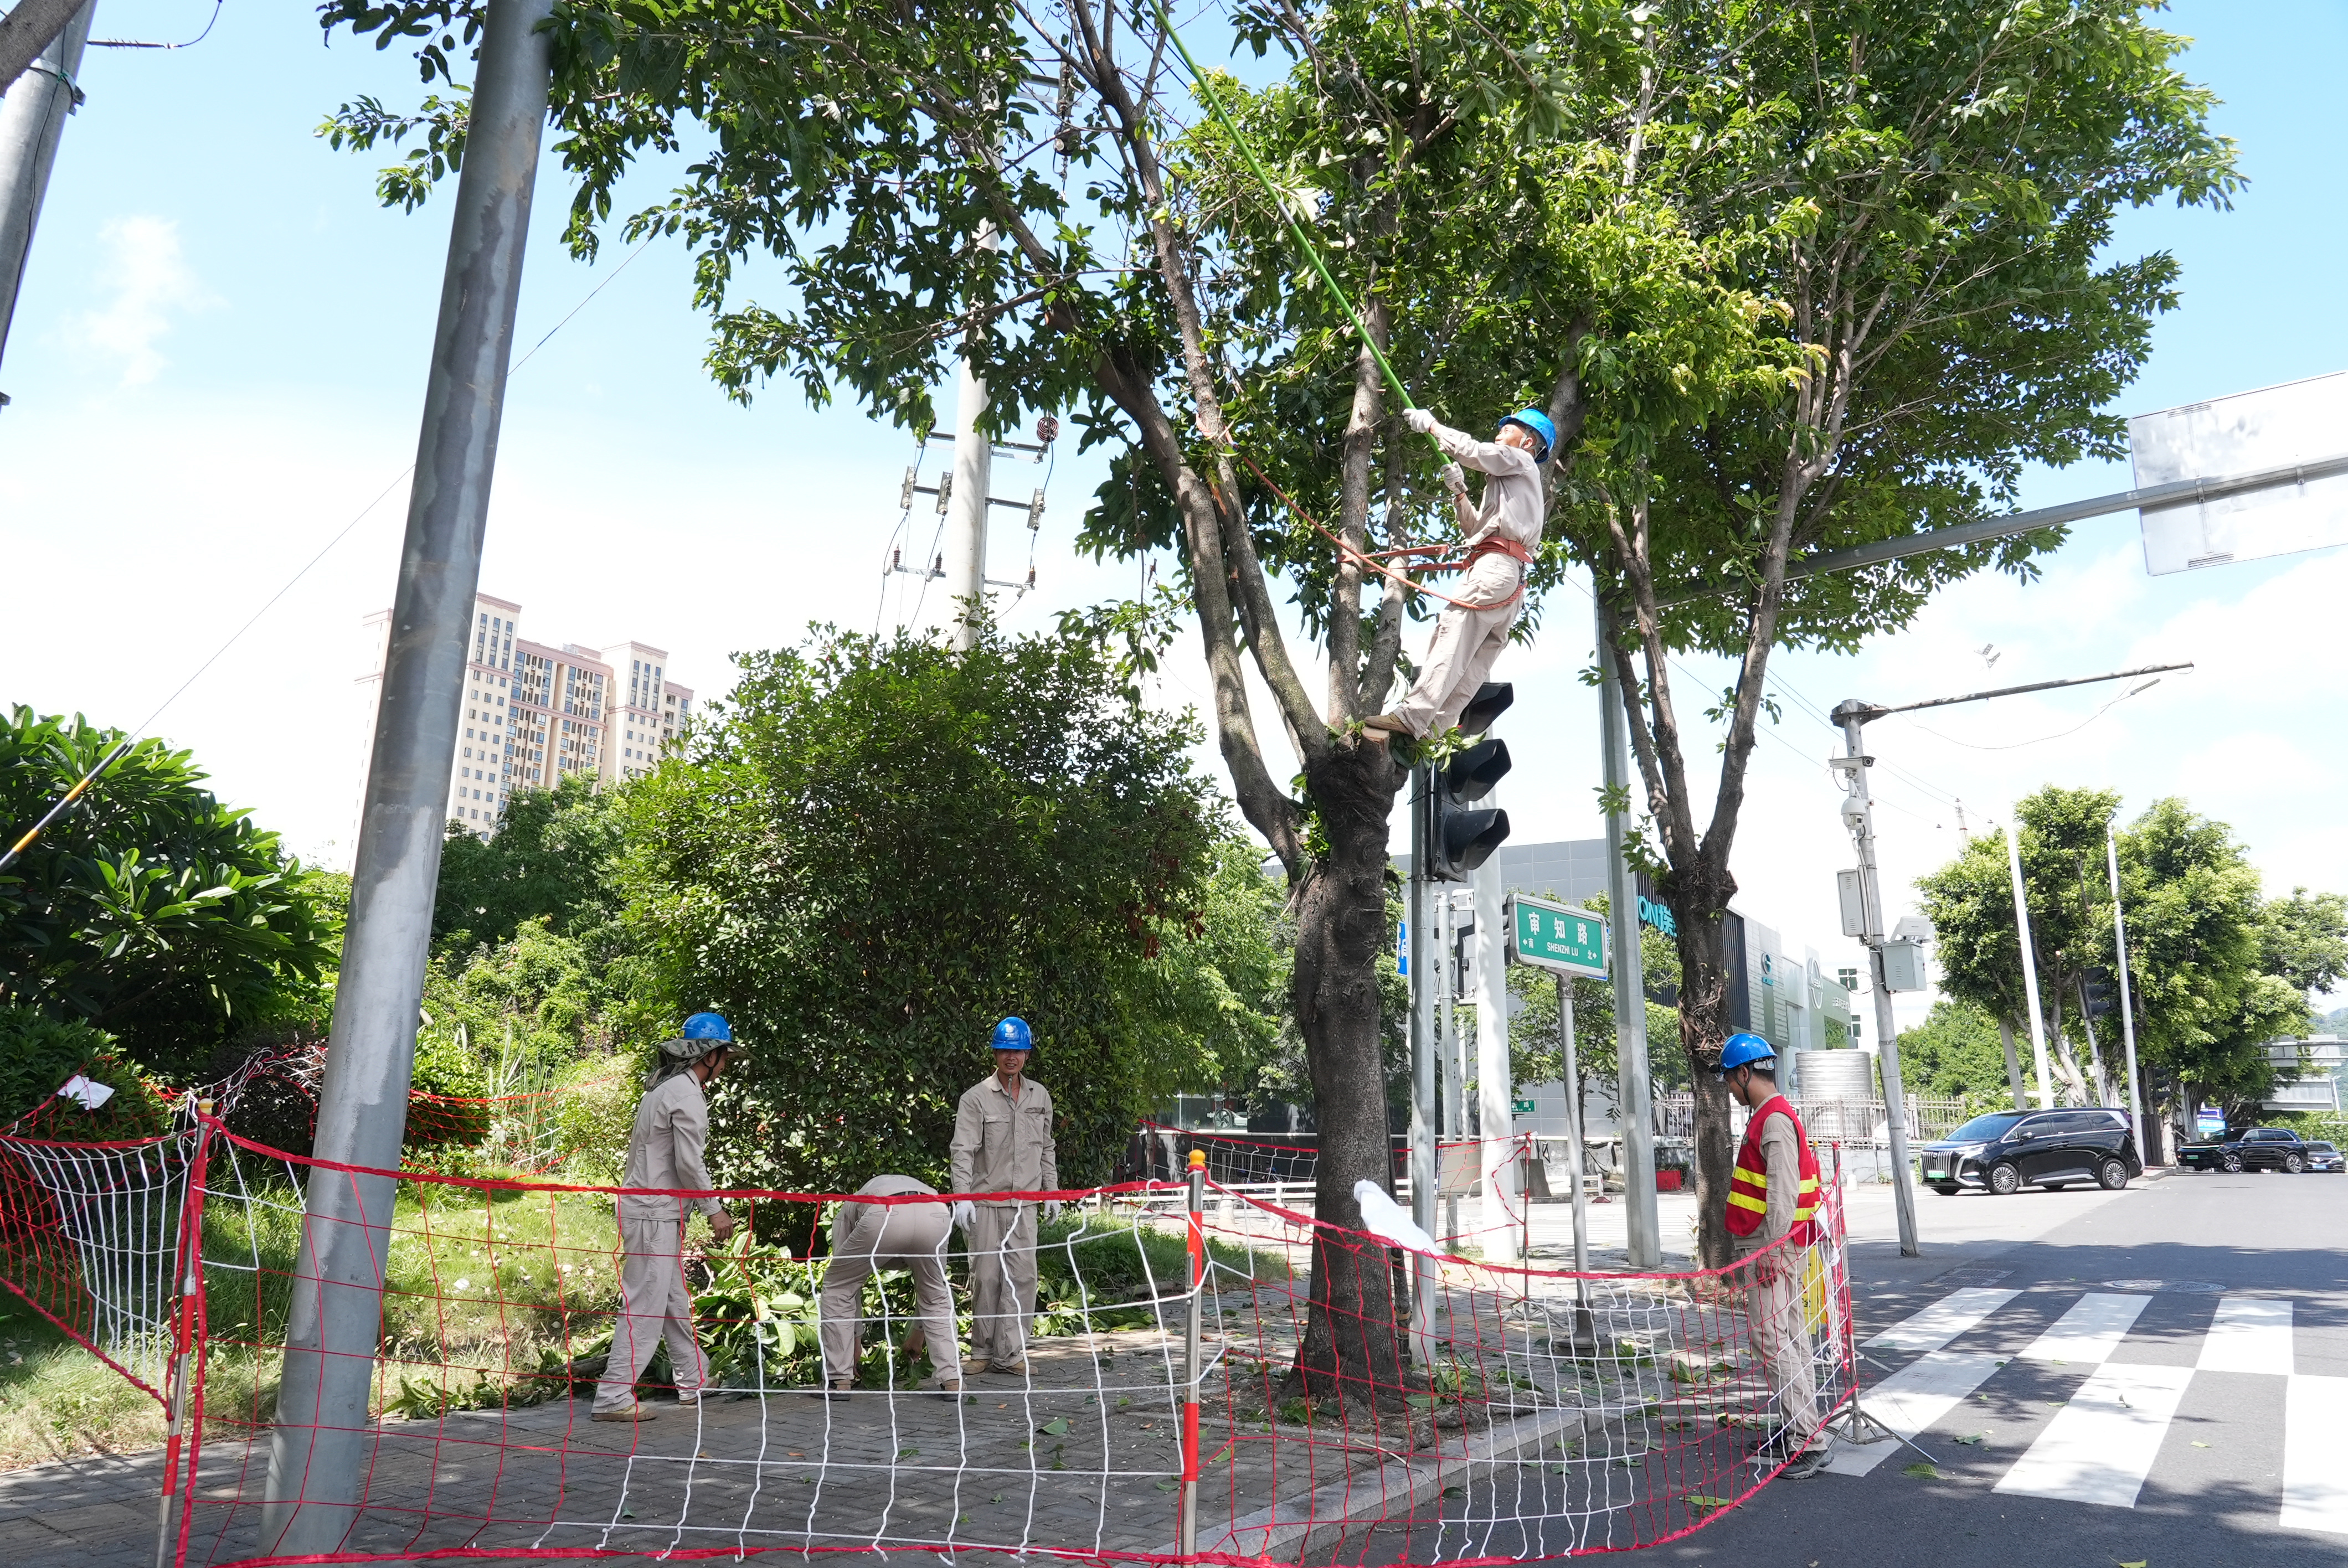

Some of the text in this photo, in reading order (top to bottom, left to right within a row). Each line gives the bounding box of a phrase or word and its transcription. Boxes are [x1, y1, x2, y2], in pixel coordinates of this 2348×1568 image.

[1528, 911, 1588, 945] 审知路
[1528, 937, 1534, 948] 南
[1547, 942, 1578, 956] SHENZHI LU
[1587, 950, 1593, 960] 北
